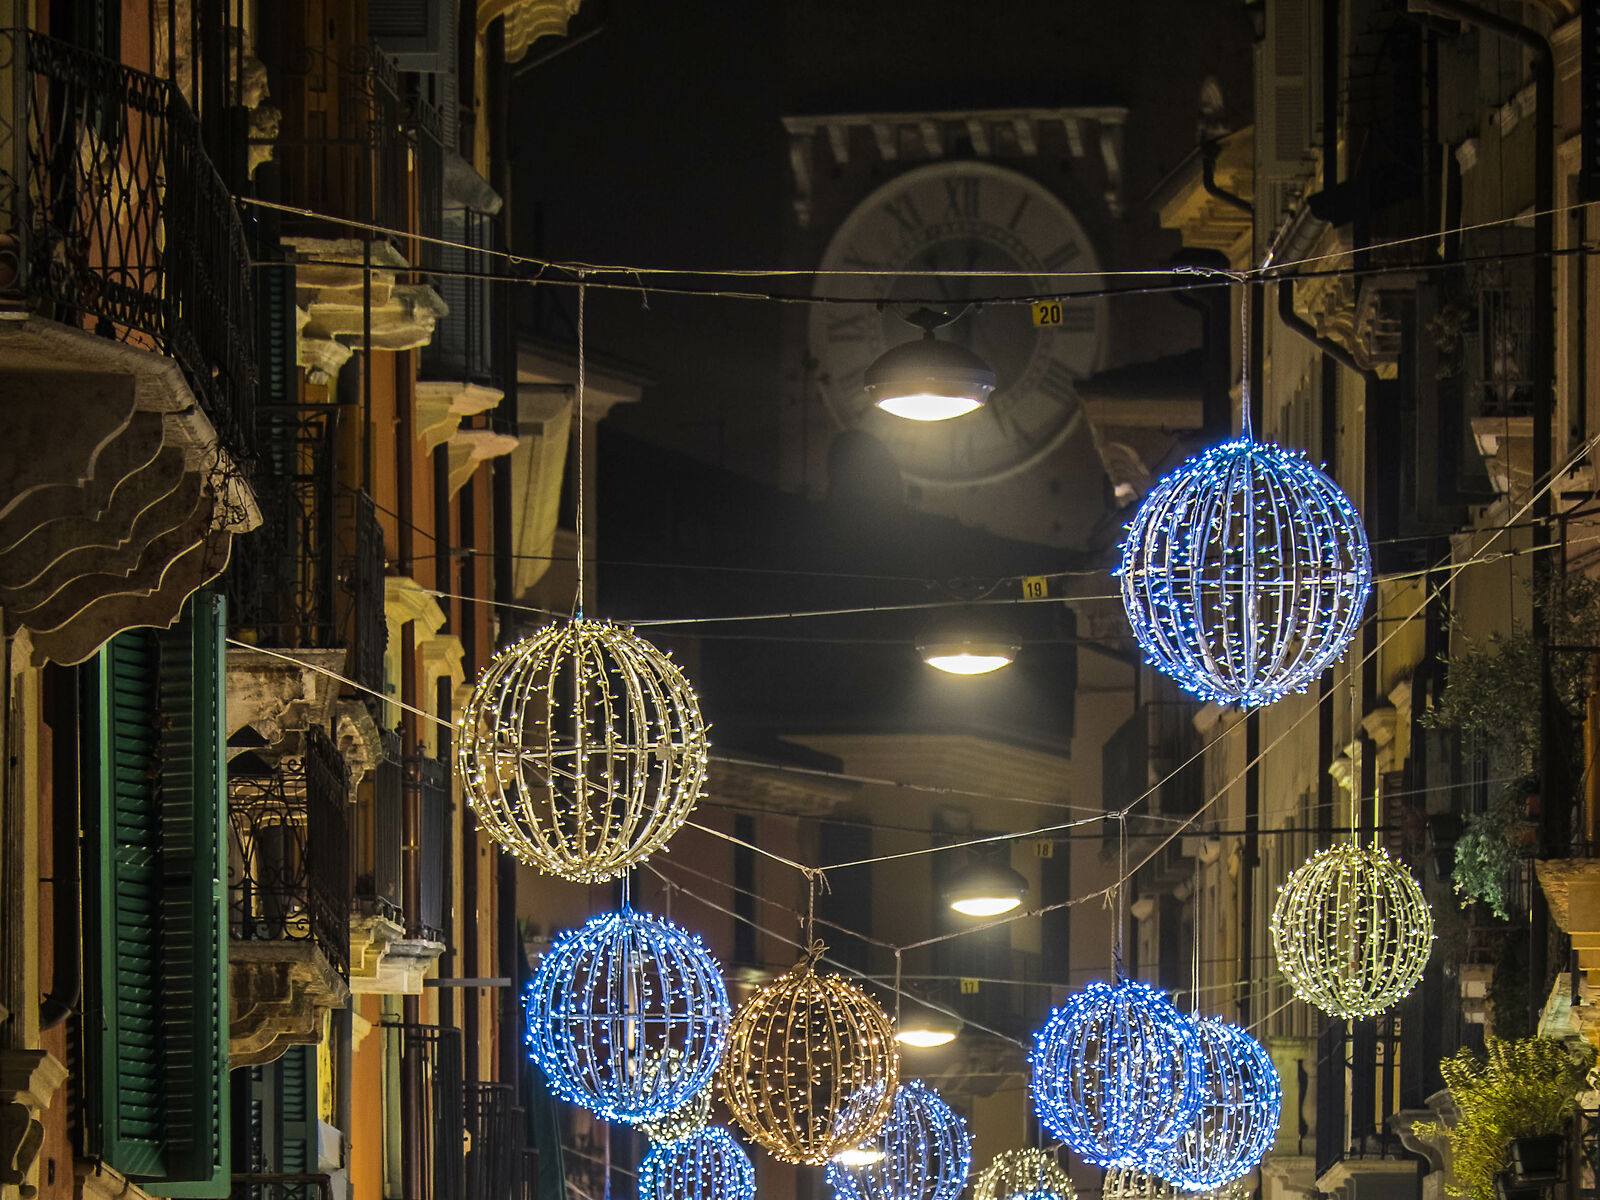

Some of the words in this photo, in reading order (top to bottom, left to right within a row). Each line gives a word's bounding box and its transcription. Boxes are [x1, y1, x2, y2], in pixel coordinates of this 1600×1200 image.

[1040, 305, 1061, 324] 20
[1027, 582, 1042, 597] 19
[1037, 843, 1049, 857] 18
[964, 982, 974, 993] 17
